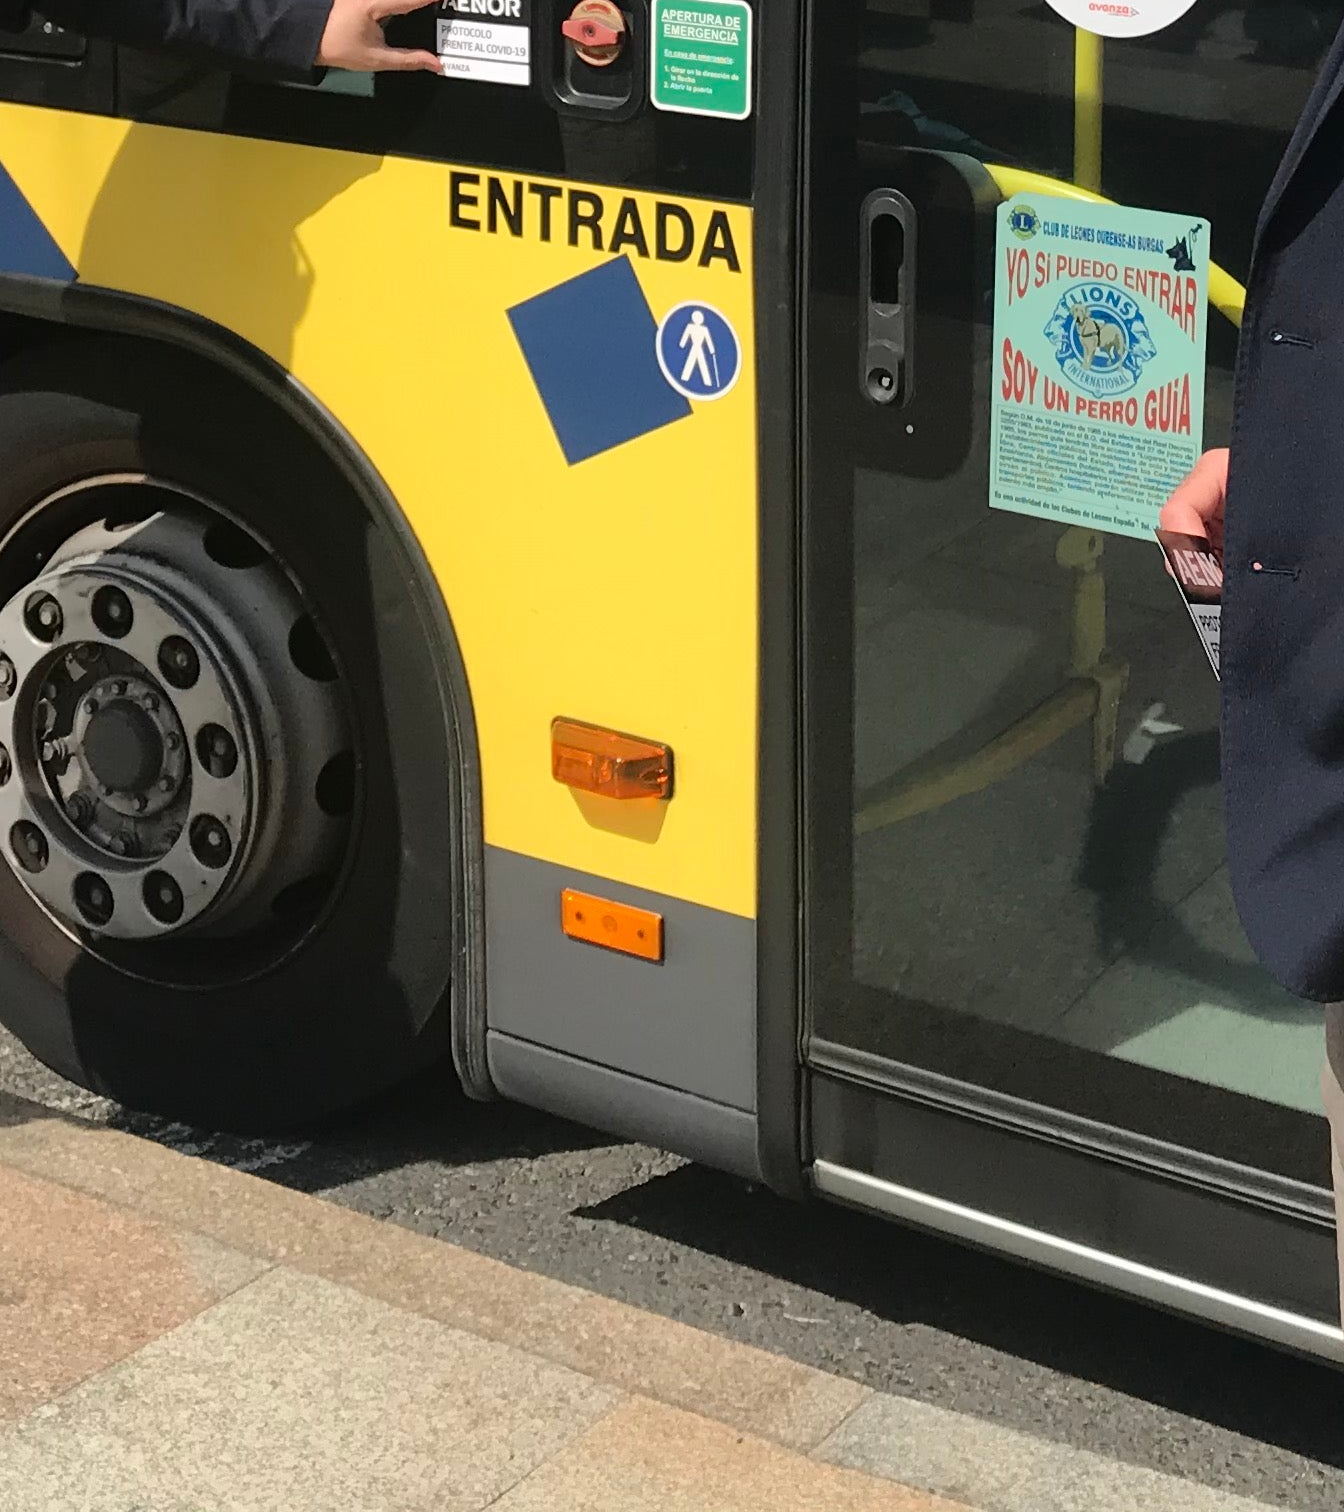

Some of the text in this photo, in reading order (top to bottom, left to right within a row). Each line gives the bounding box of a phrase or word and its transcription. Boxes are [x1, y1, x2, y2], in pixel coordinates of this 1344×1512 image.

[662, 8, 740, 28] APERTURA DE
[1089, 2, 1129, 14] avanza
[441, 25, 492, 39] PROTOCOLO
[663, 24, 738, 42] EMERGENCIA
[441, 39, 526, 57] FRENTE AL COVID-19
[449, 171, 741, 274] ENTRADA
[1043, 221, 1164, 254] CLUB DE LEONES OURENSE-AS BURGAS
[1006, 247, 1030, 307] YO
[1056, 255, 1118, 281] PUEDO
[1124, 266, 1197, 344] ENTRAR
[1070, 287, 1133, 316] LIONS
[1002, 337, 1038, 405] SOY
[1044, 375, 1070, 413] UN
[1076, 396, 1138, 427] PERRO
[1068, 363, 1130, 389] INTERNATIONAL
